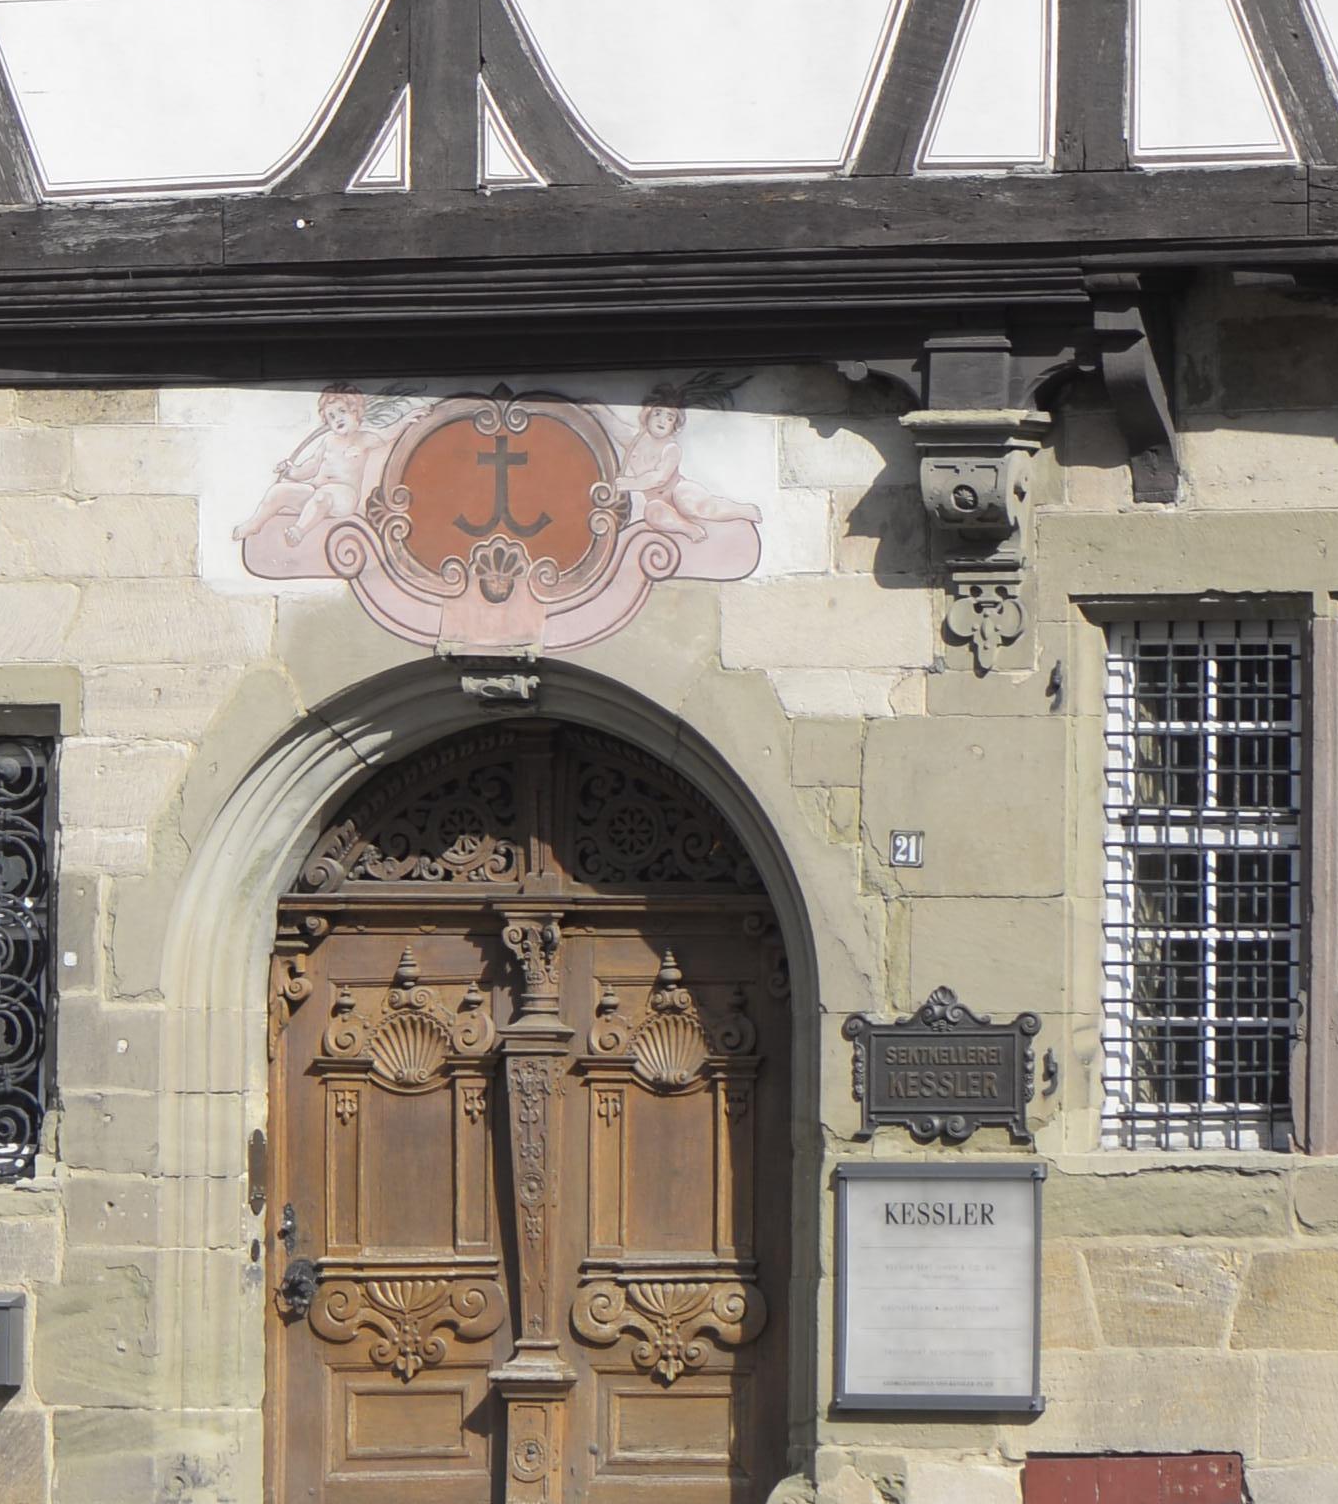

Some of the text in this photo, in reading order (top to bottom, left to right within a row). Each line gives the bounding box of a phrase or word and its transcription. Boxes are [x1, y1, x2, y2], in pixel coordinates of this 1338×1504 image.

[895, 835, 917, 862] 21
[885, 1046, 1003, 1066] SEKTKELLEREI
[889, 1071, 998, 1099] KESSLER
[885, 1202, 995, 1225] KESSLER
